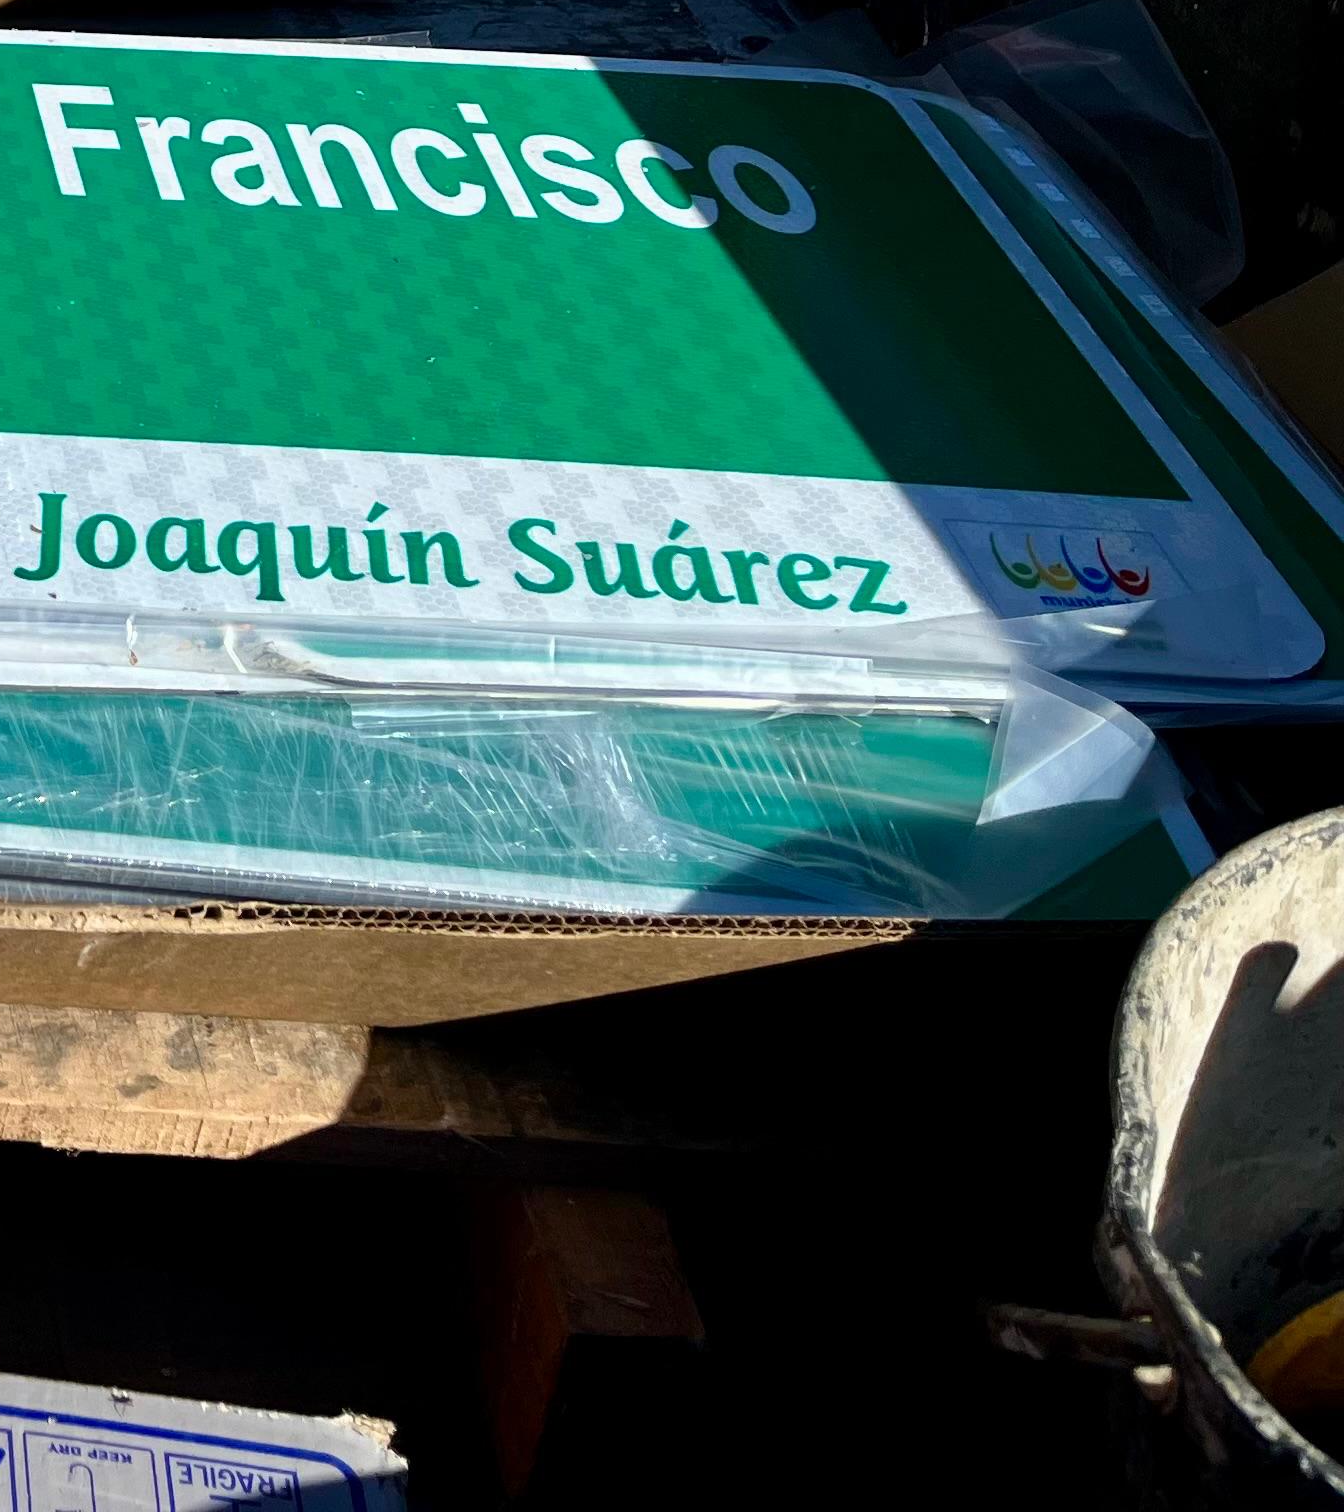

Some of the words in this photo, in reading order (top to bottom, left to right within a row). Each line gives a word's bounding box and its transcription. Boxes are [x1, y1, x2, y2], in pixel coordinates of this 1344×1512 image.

[32, 83, 818, 235] Francisco
[15, 491, 481, 601] Joaquín
[507, 518, 909, 616] Suárez
[49, 1442, 82, 1457] DRY
[87, 1448, 132, 1464] KEEP
[179, 1460, 294, 1502] FRAGILE
